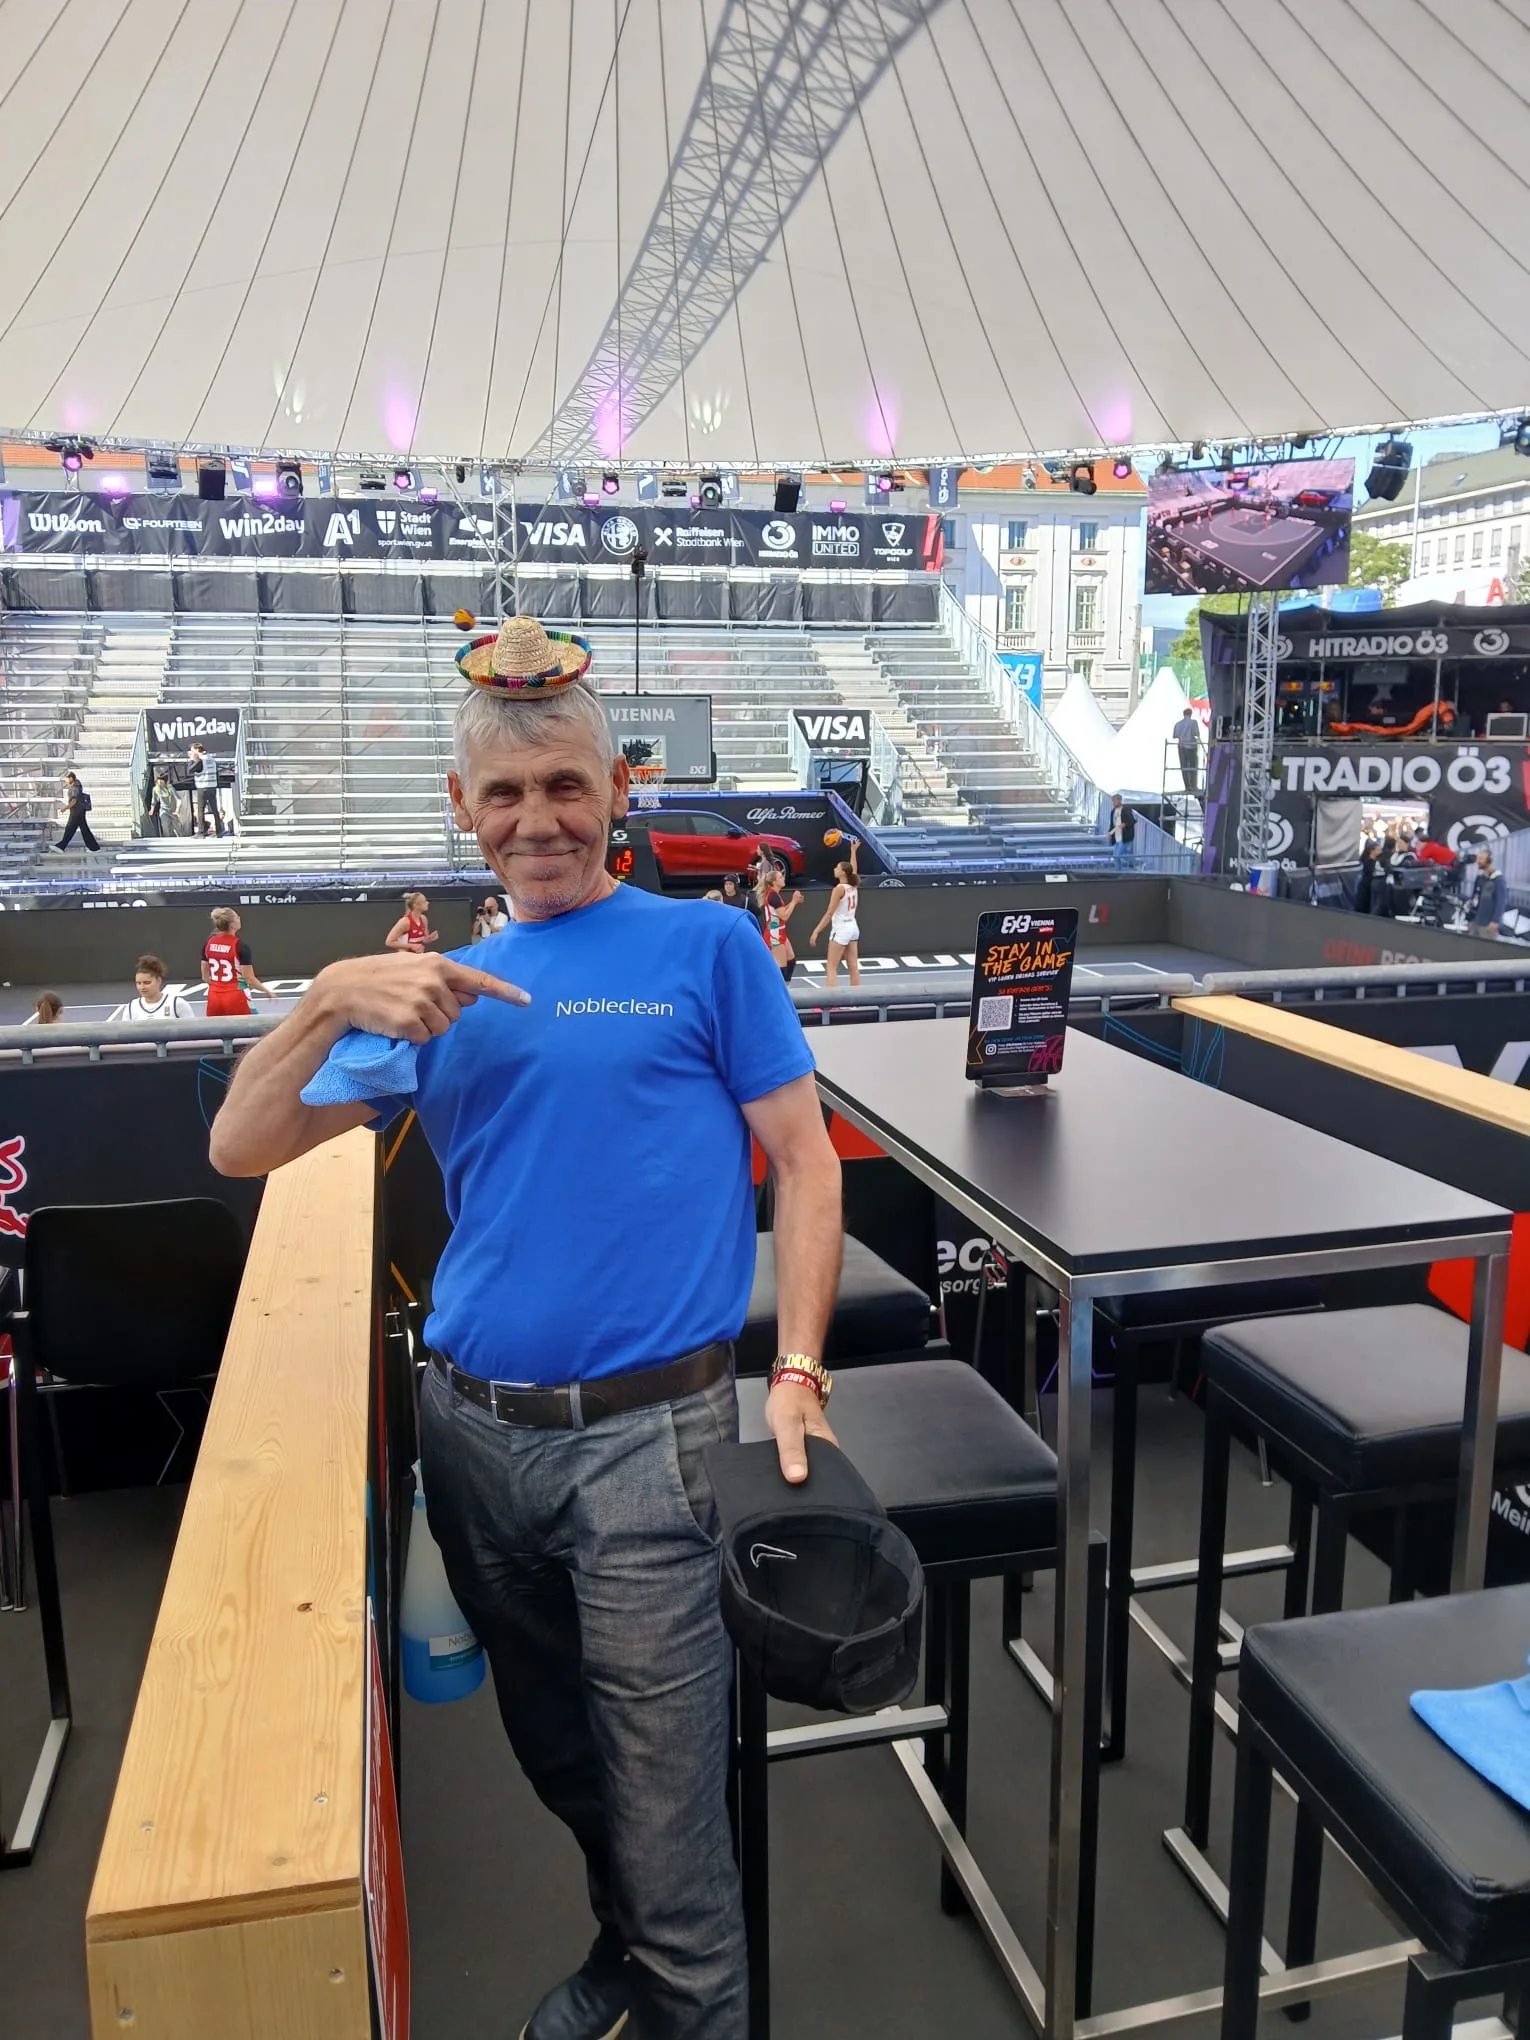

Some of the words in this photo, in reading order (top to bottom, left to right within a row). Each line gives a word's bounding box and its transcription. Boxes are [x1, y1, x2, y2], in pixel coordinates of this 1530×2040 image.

[28, 512, 105, 533] Wilson
[143, 519, 203, 529] FOURTEEN
[219, 513, 305, 540] win2day
[323, 509, 361, 547] A1
[400, 510, 431, 524] Stadt
[401, 523, 432, 536] Wien
[520, 521, 586, 547] VISA
[812, 525, 860, 541] IMMO
[815, 544, 857, 554] UNITED
[1309, 635, 1412, 658] HITRADIO
[1416, 629, 1449, 655] Ö3
[609, 707, 676, 722] VIENNA
[153, 716, 236, 743] win2day
[798, 715, 866, 741] VISA
[1273, 755, 1442, 793] TRADIO
[1447, 746, 1512, 794] Ö3
[746, 807, 782, 825] Alfa
[780, 806, 826, 820] Romeo
[1031, 919, 1055, 927] VIENNA
[987, 941, 1031, 962] STAY
[1035, 938, 1053, 956] IN
[208, 958, 234, 982] 23
[981, 957, 1018, 976] THE
[1020, 952, 1072, 972] GAME
[556, 997, 673, 1018] Nobleclean
